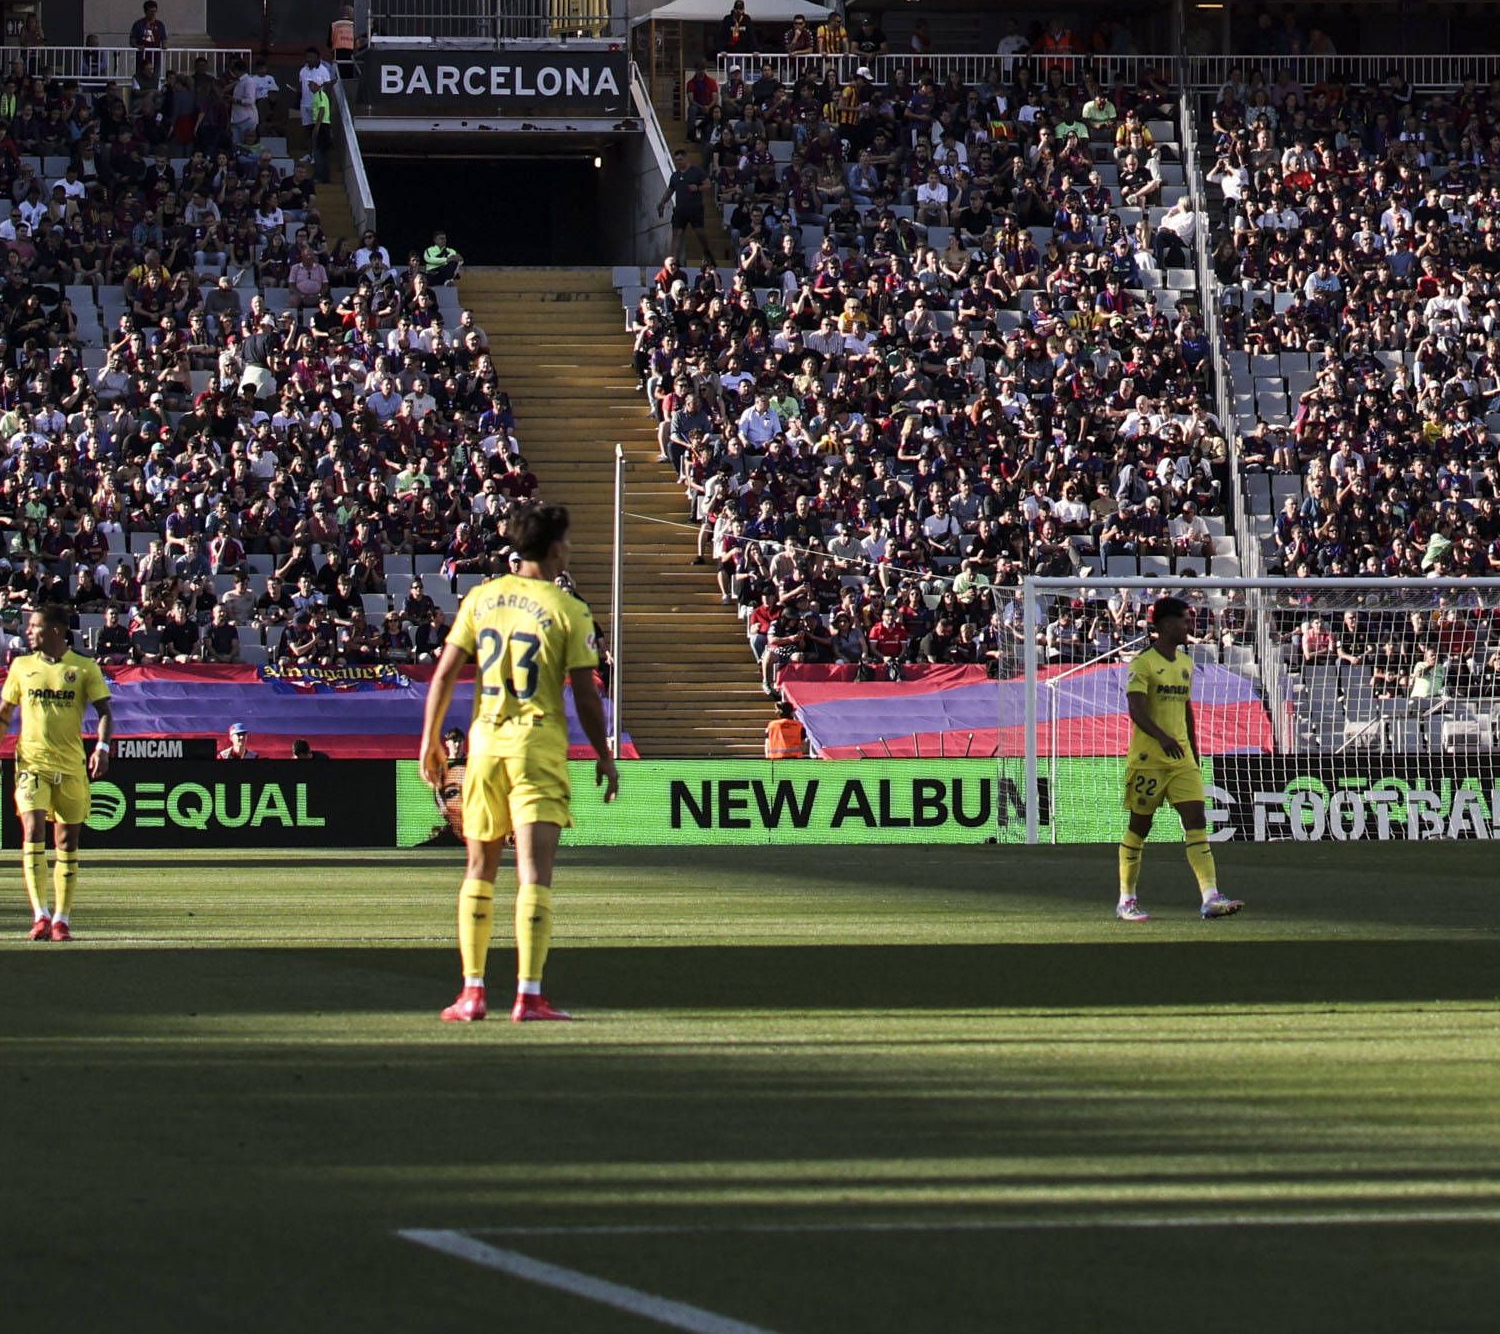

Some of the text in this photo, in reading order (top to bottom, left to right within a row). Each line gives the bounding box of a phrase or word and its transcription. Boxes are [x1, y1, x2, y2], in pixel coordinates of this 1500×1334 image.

[380, 65, 620, 96] BARCELONA
[486, 595, 553, 629] CARDONA
[476, 628, 542, 699] 23
[20, 773, 39, 789] 21
[1135, 775, 1157, 796] 22
[135, 782, 325, 830] EQUAL
[670, 779, 819, 829] NEW
